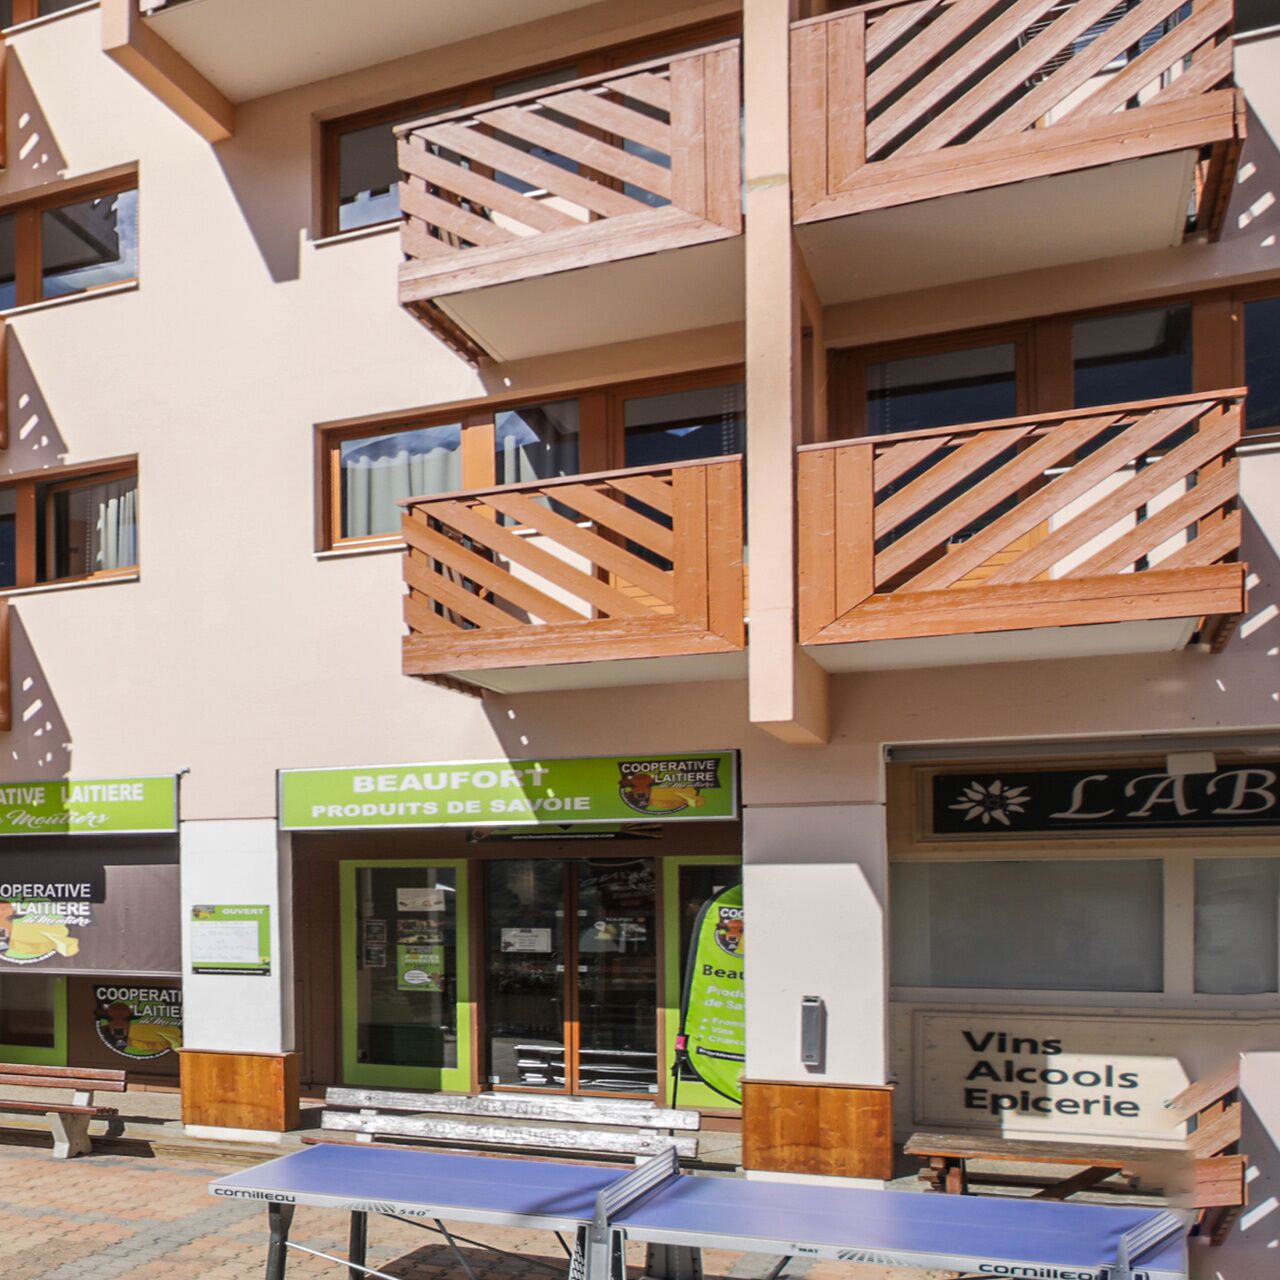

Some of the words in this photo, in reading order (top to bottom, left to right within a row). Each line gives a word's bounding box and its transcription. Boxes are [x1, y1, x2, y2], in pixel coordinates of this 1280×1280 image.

[621, 760, 716, 773] COOPERATIVE
[353, 768, 549, 794] BEAUFORT
[654, 772, 715, 783] LAITIERE
[61, 783, 145, 803] LAITIERE
[311, 801, 439, 818] PRODUITS
[447, 799, 482, 814] DE
[489, 796, 592, 813] SAVOIE
[16, 902, 91, 916] LAITIERE
[134, 1004, 183, 1018] LAITIE
[726, 1001, 745, 1010] Sa
[962, 1031, 1063, 1056] Vins
[966, 1060, 1139, 1089] Alcools
[964, 1087, 1140, 1117] Epicerie
[214, 1187, 296, 1203] cornilleau
